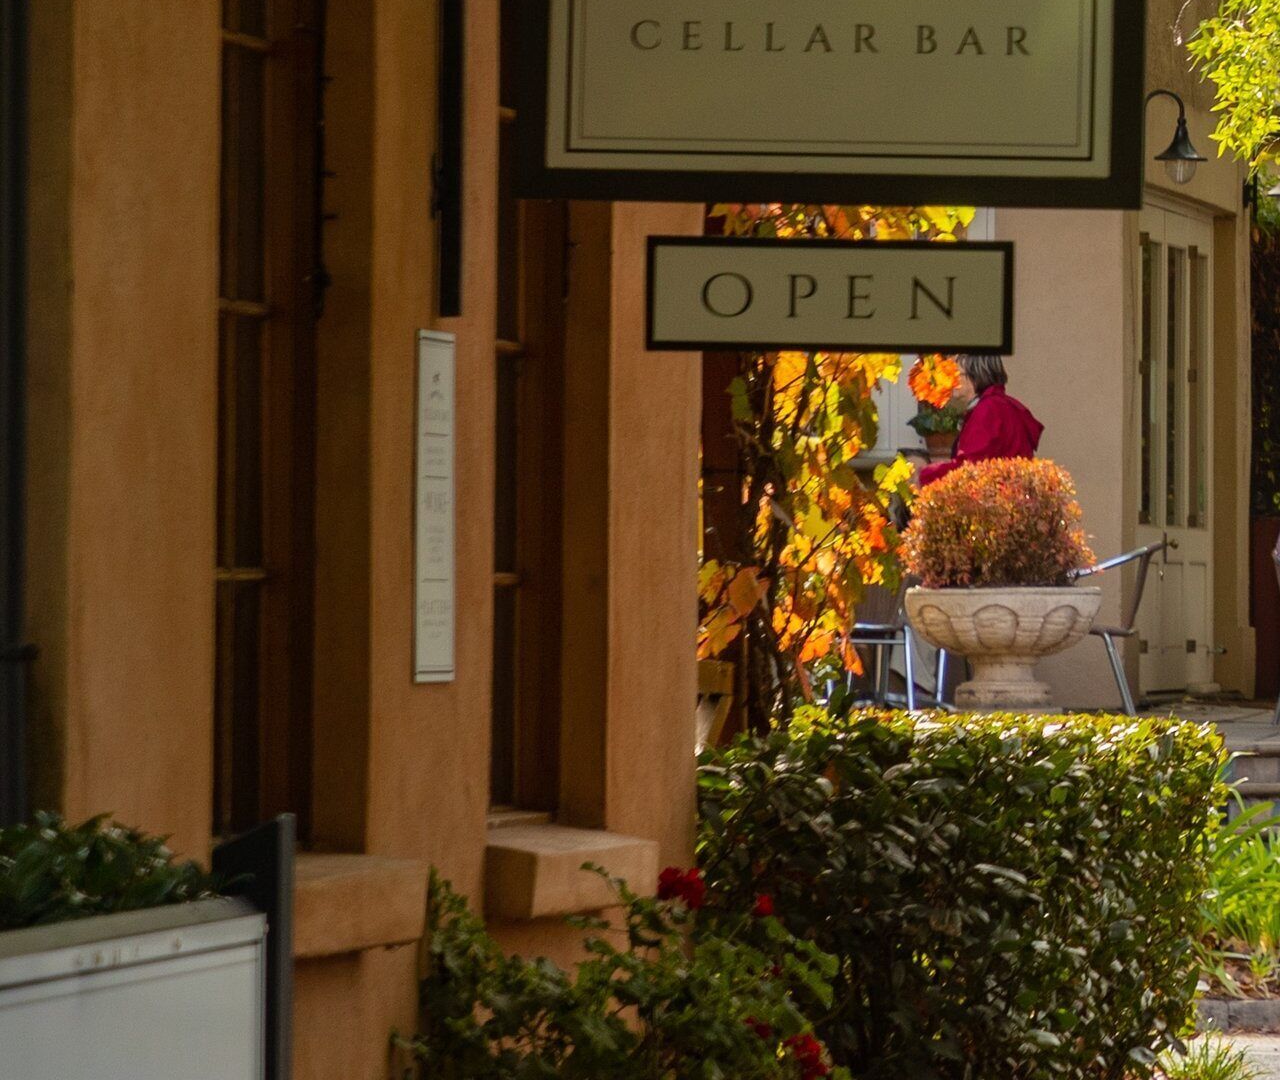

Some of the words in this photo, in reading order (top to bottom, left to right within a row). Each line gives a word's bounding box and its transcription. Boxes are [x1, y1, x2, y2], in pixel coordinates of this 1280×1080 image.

[630, 20, 879, 54] CELLAR
[915, 24, 1031, 56] BAR
[701, 272, 957, 320] OPEN
